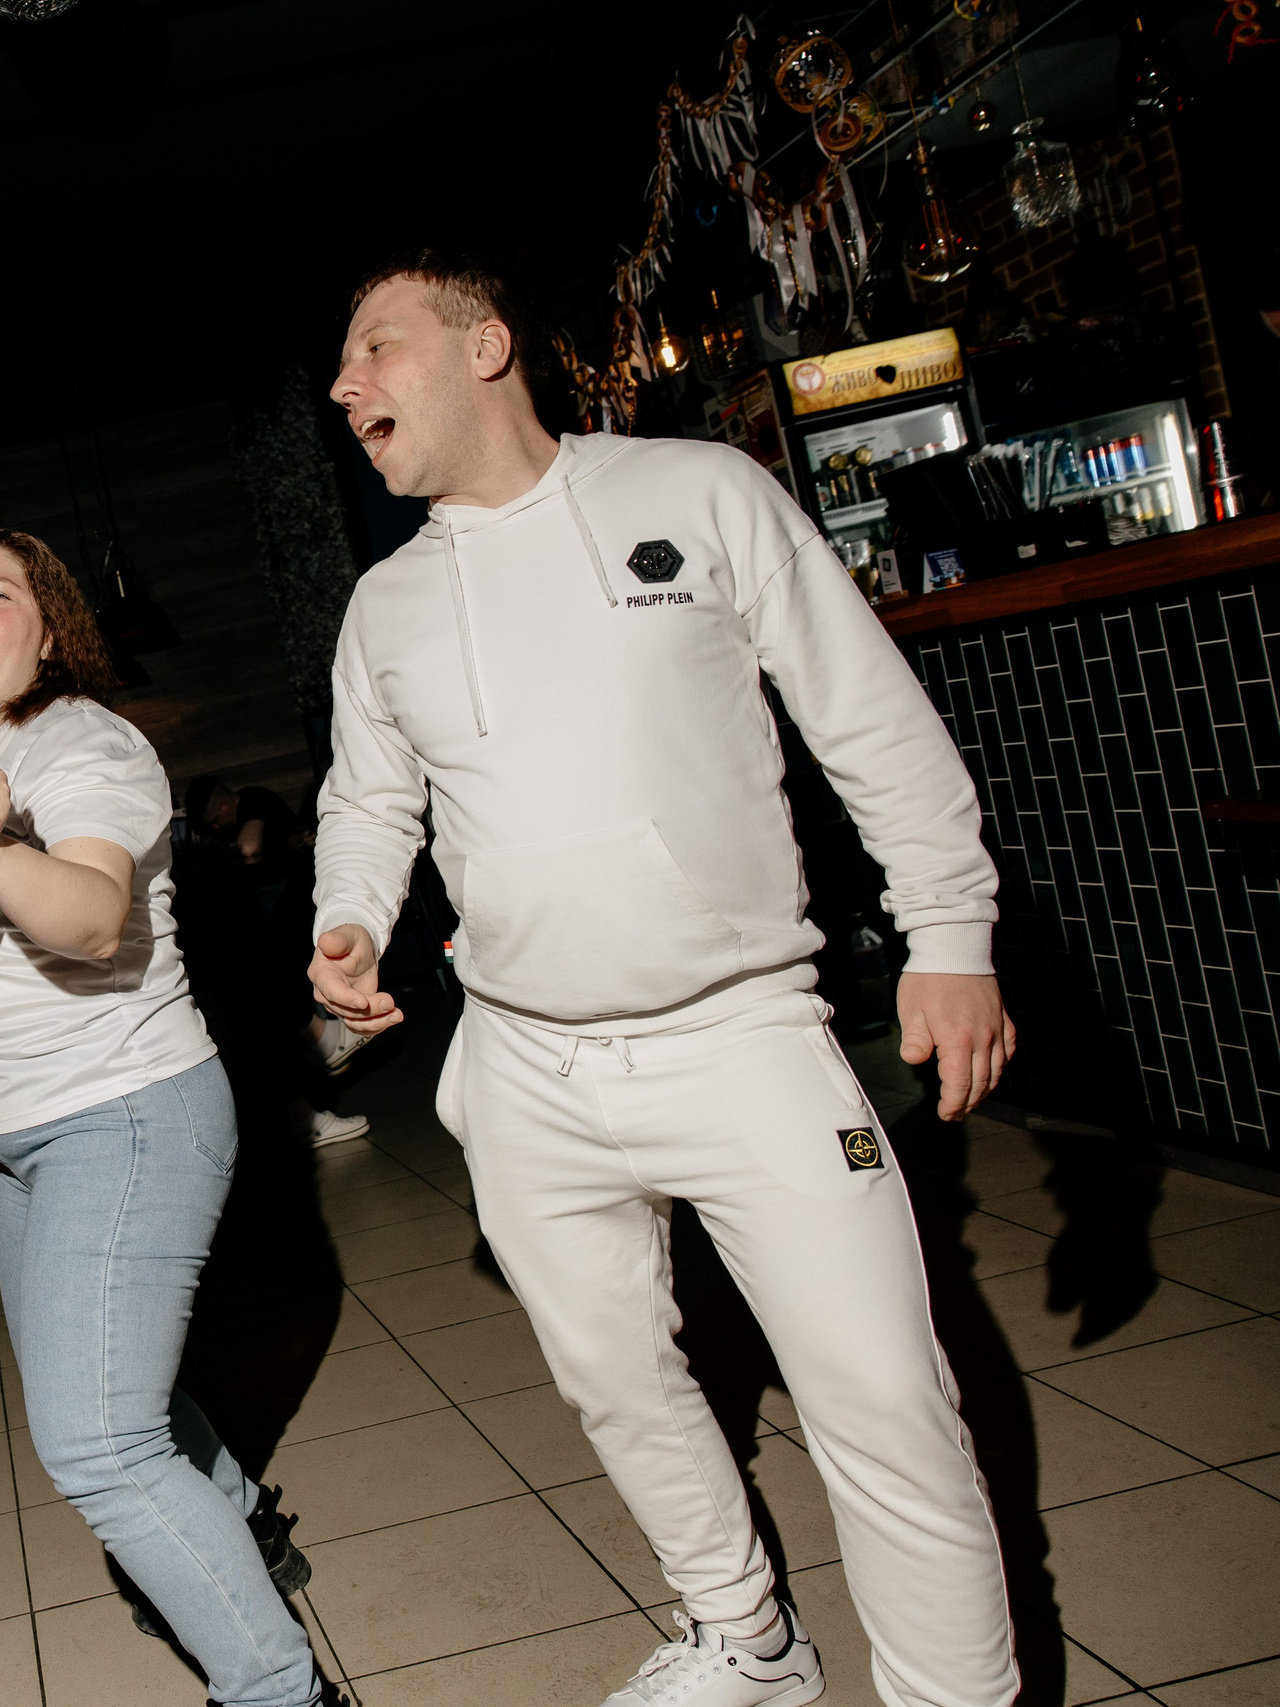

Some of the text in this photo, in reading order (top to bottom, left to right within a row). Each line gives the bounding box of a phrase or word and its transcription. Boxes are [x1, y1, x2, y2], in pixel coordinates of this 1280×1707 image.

[900, 360, 957, 391] ПИВО
[626, 591, 694, 609] PHILIPP PLEIN
